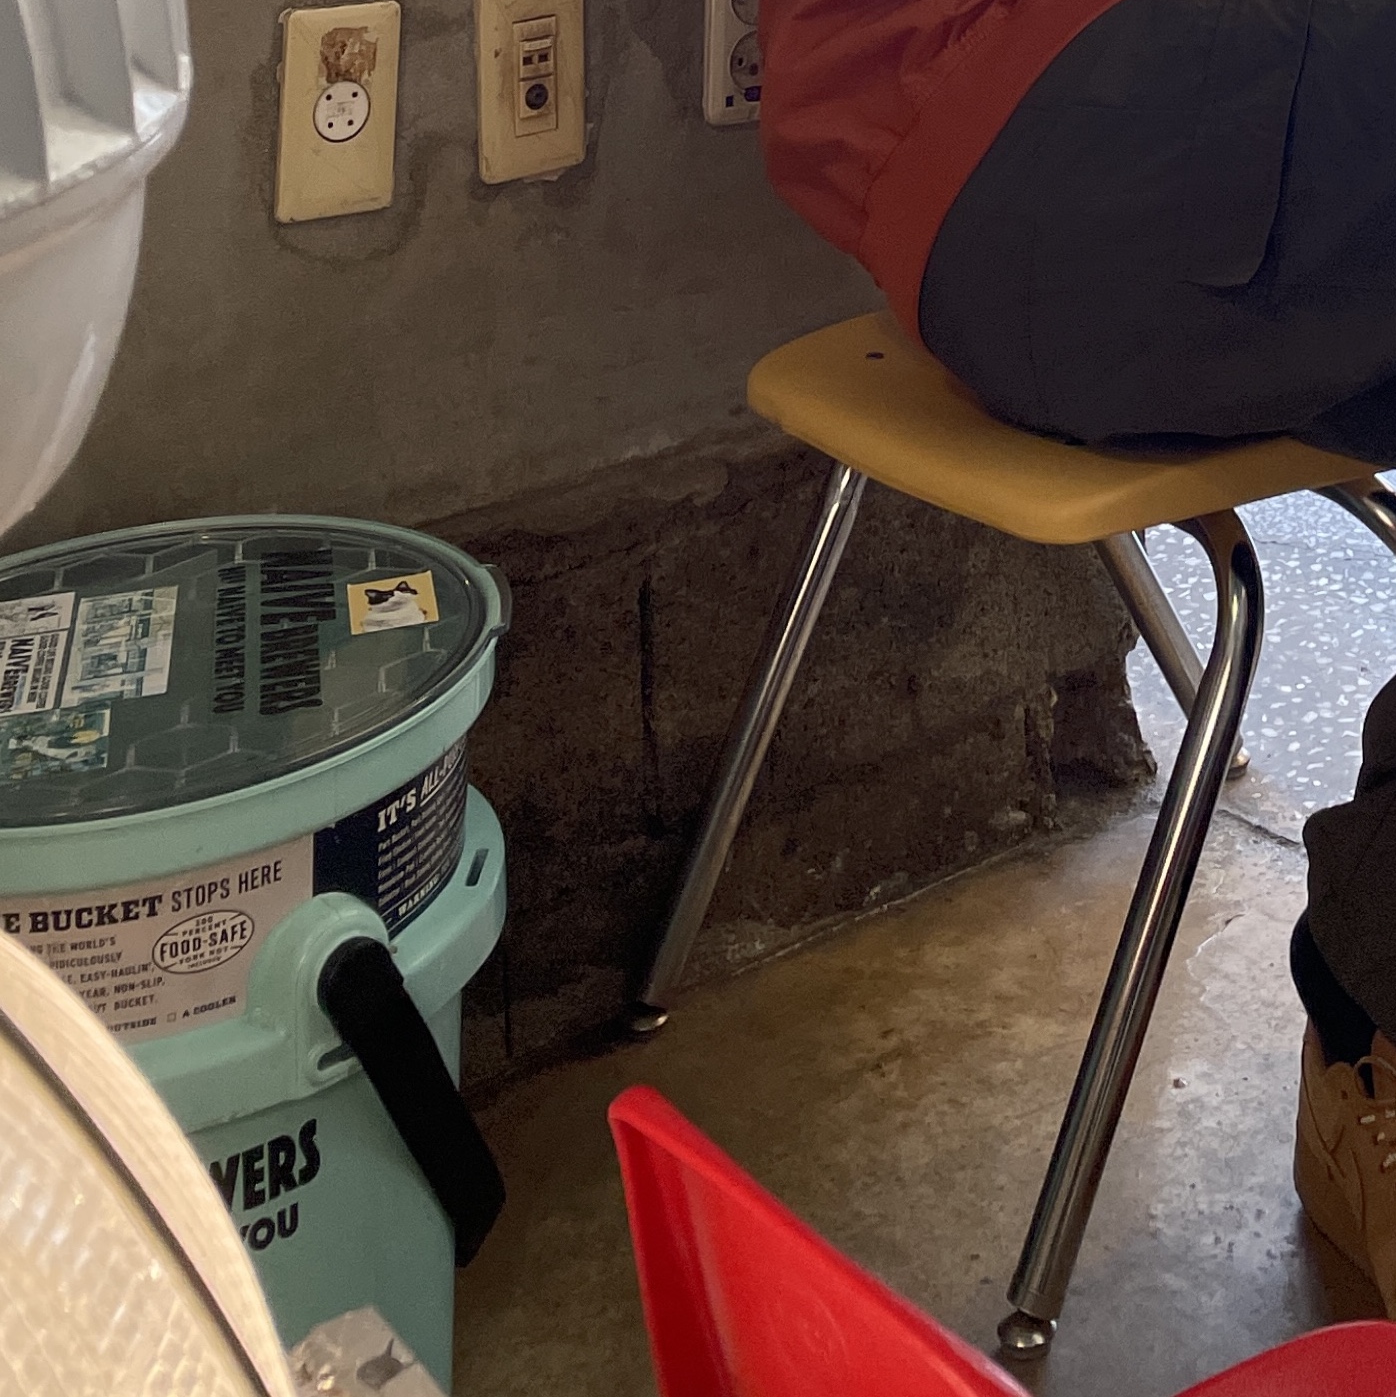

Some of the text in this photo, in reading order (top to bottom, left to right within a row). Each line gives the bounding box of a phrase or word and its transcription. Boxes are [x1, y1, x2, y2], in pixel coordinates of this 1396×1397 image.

[377, 787, 417, 832] IT'S
[29, 894, 163, 934] BUCKET
[171, 878, 230, 913] STOPS
[238, 860, 283, 895] HERE
[70, 936, 116, 952] WORLD'S
[160, 919, 248, 963] FOOD-SAFE
[182, 918, 227, 937] PERCENT
